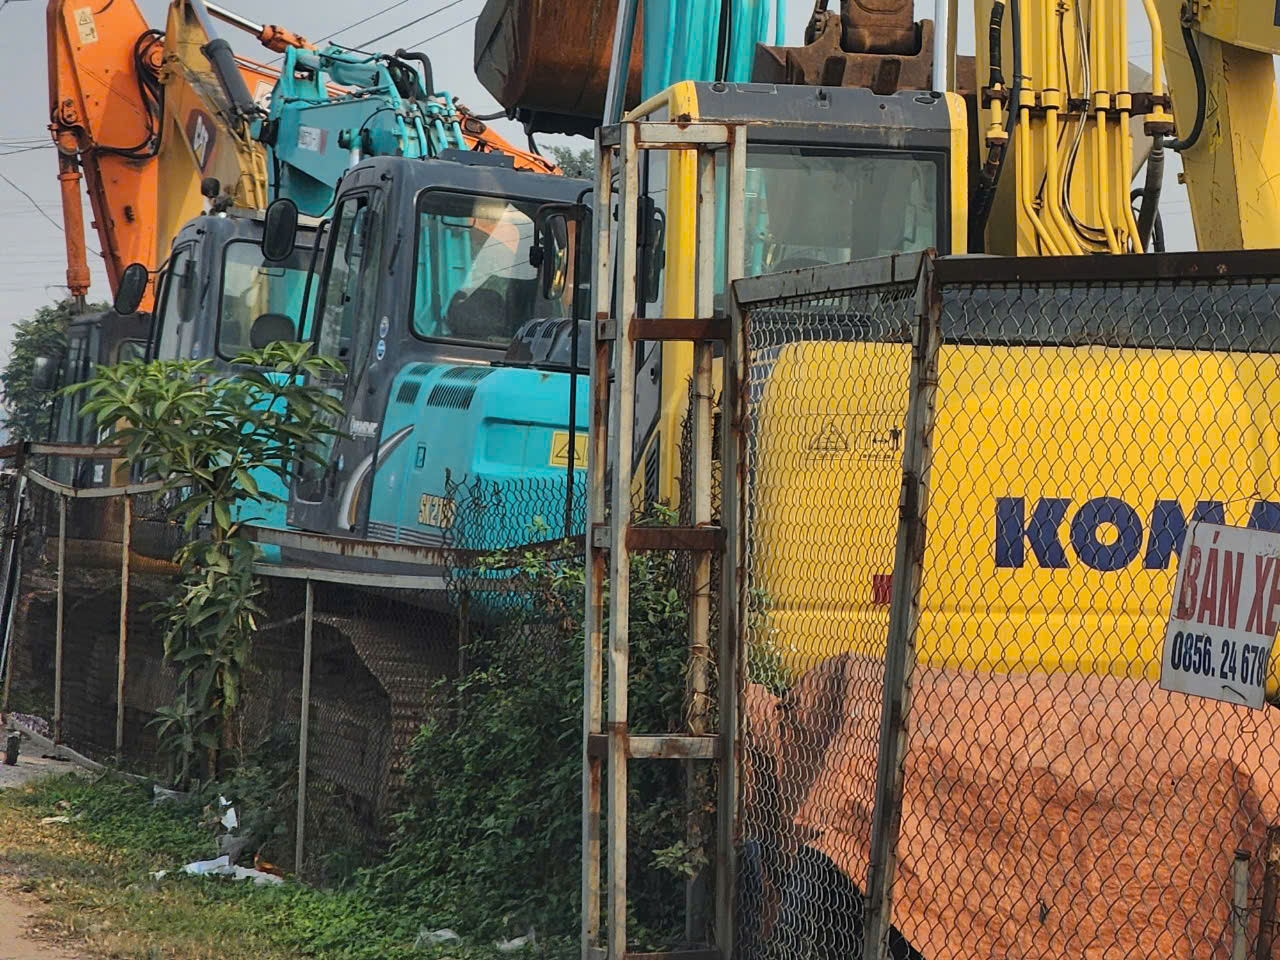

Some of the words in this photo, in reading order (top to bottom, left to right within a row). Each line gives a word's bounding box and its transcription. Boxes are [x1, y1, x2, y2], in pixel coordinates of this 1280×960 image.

[1175, 531, 1245, 630] BÁN
[1170, 631, 1216, 677] 0856.
[1219, 639, 1237, 681] 24
